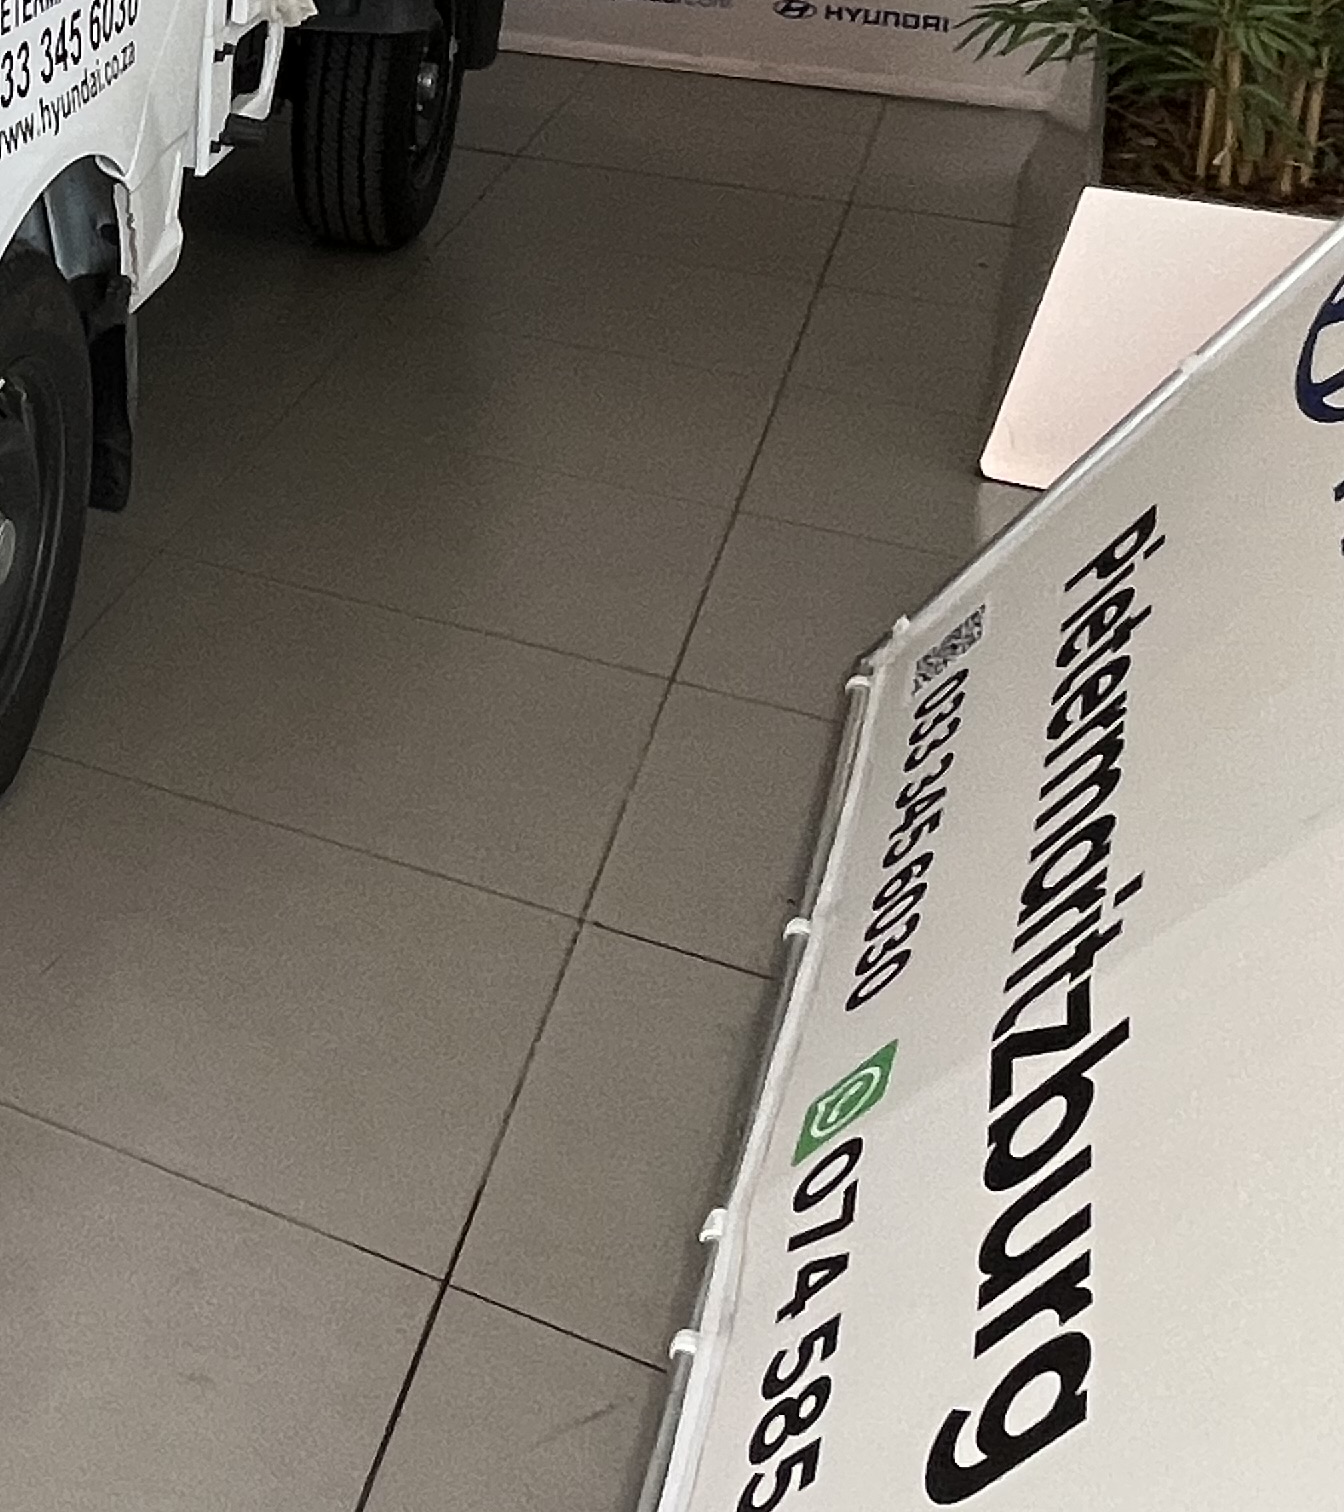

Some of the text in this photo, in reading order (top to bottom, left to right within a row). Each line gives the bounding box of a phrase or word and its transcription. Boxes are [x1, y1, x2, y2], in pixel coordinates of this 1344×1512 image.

[40, 8, 82, 84] 345
[824, 4, 950, 34] HYUNDAI
[844, 667, 970, 1012] 033 345 6030
[924, 504, 1165, 1505] Pietermaritzburg
[736, 1136, 864, 1512] 074 585
